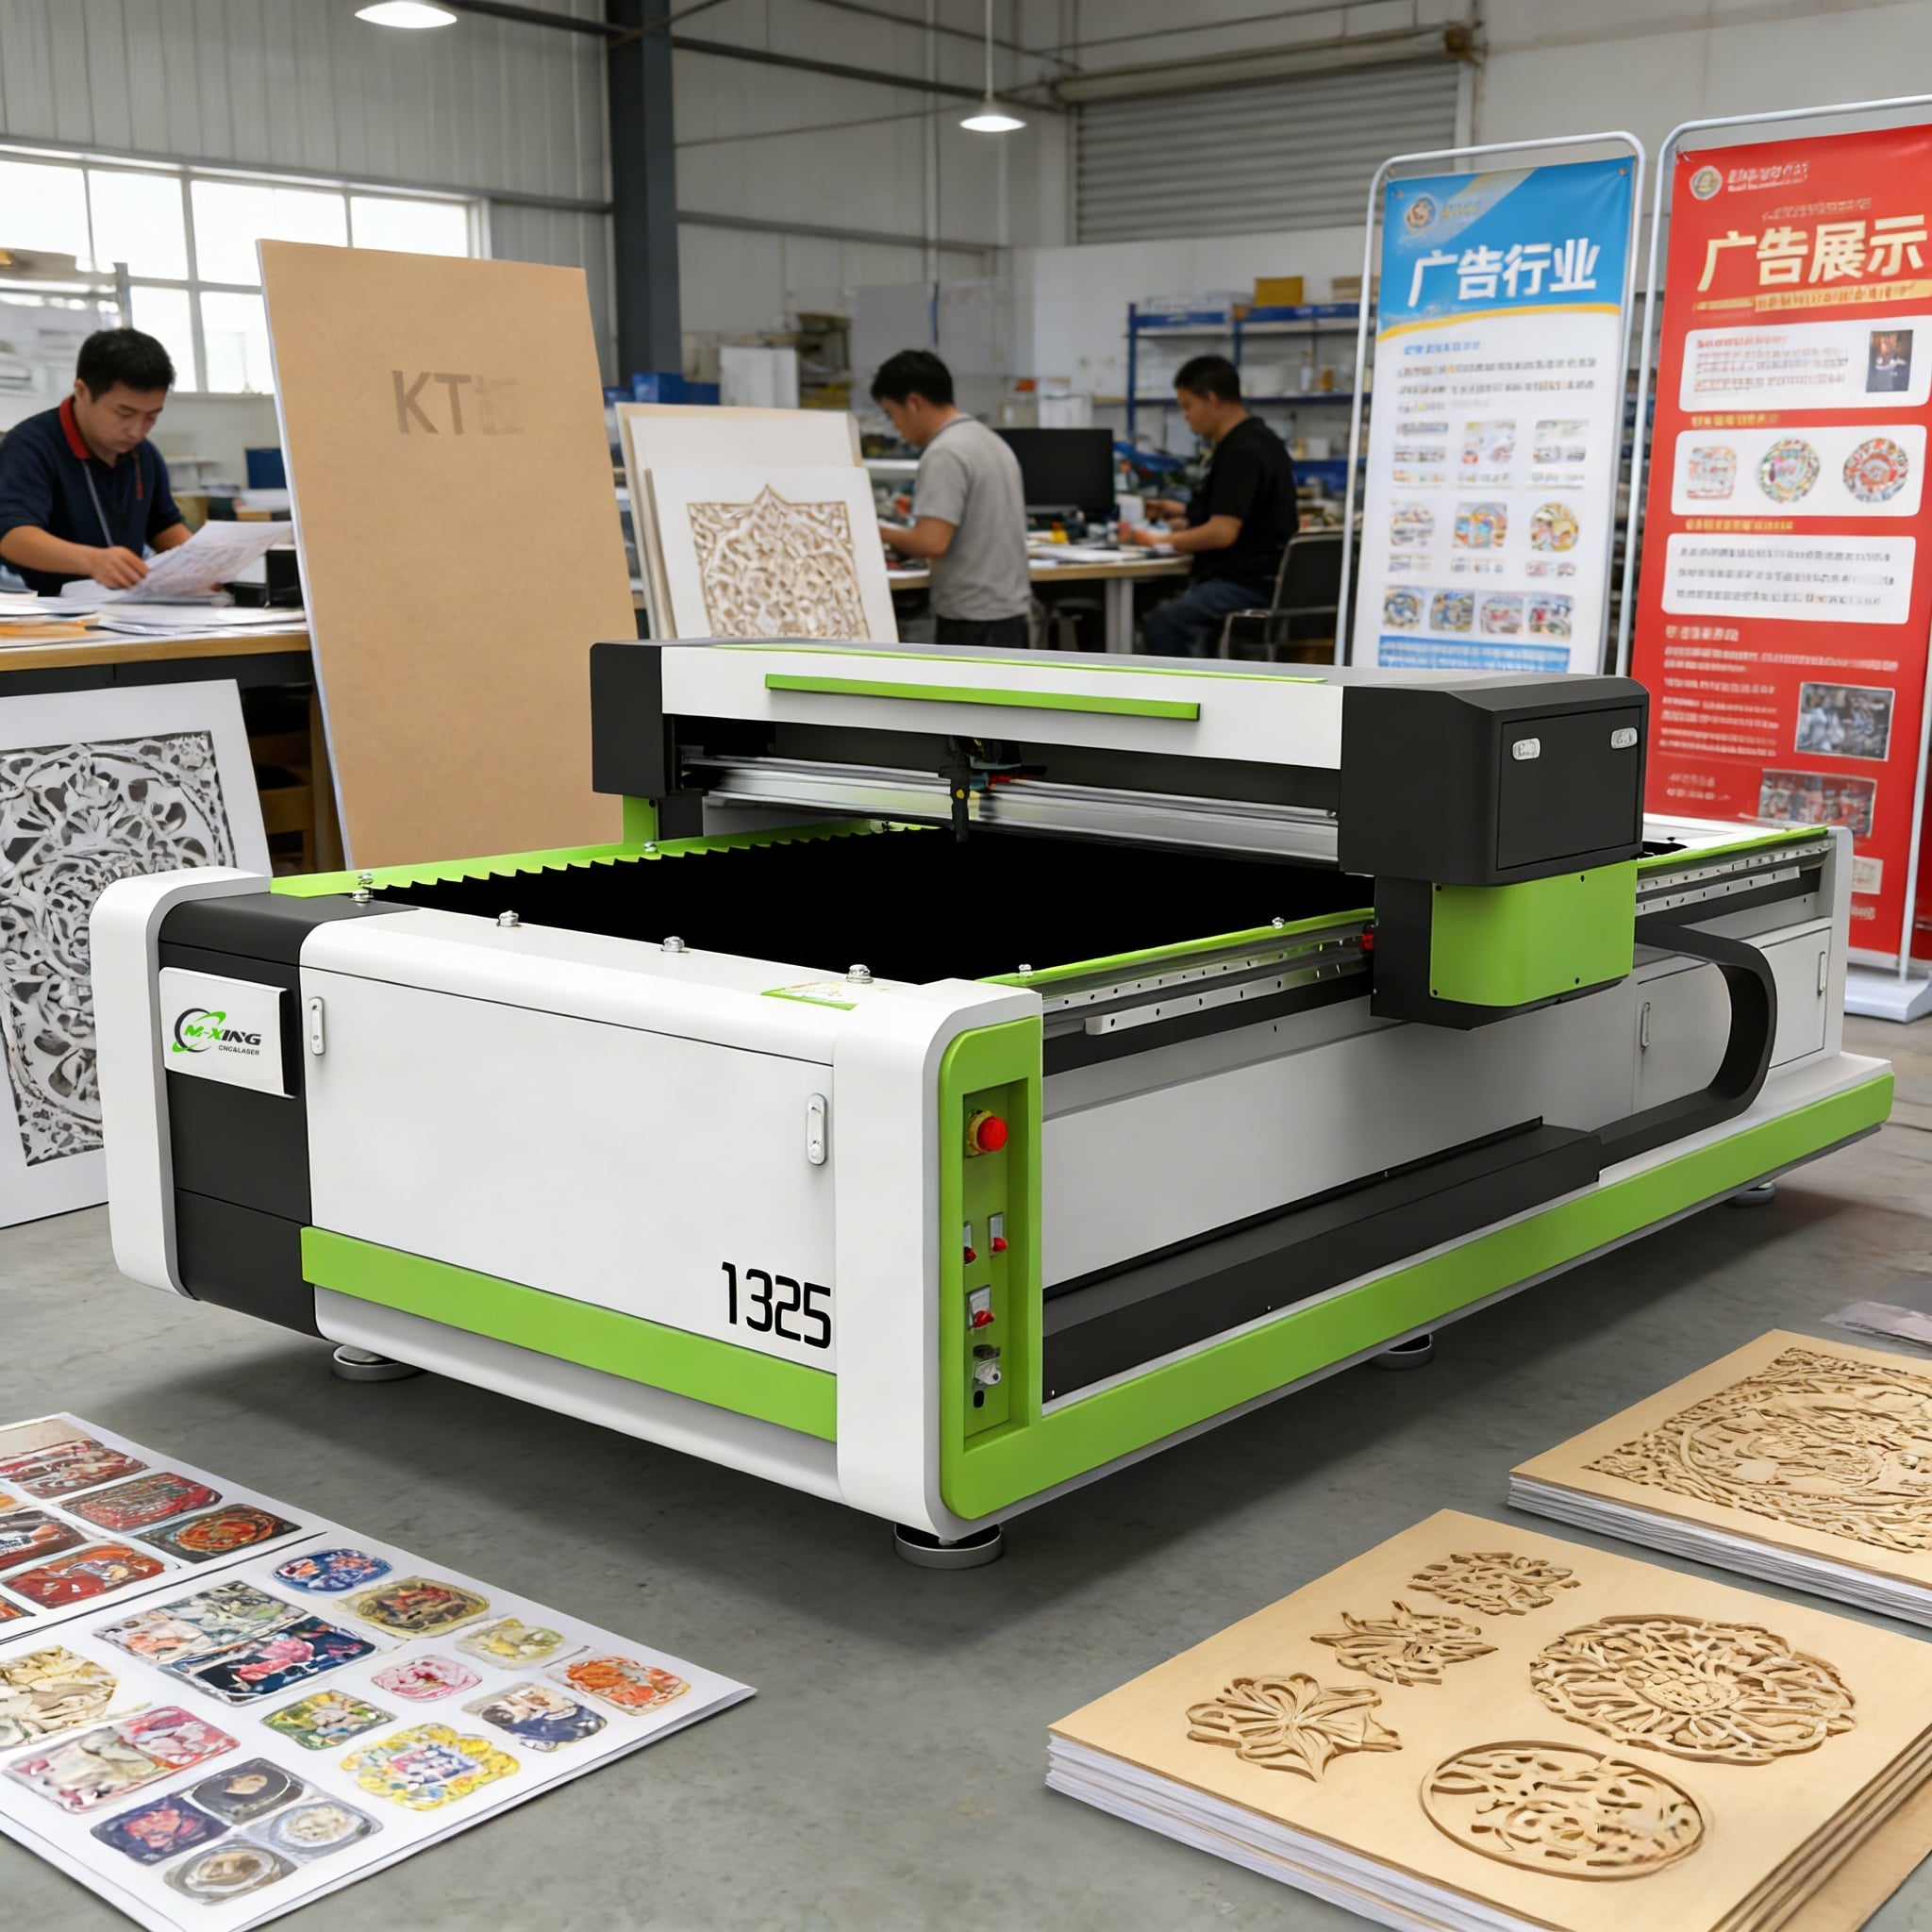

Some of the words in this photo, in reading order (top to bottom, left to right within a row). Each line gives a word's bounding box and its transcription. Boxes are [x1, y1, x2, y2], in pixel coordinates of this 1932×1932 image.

[1407, 238, 1600, 308] 广告行业
[1697, 214, 1927, 292] 广告展示
[218, 1044, 260, 1056] CNC&LASER
[722, 1260, 831, 1349] 1325
